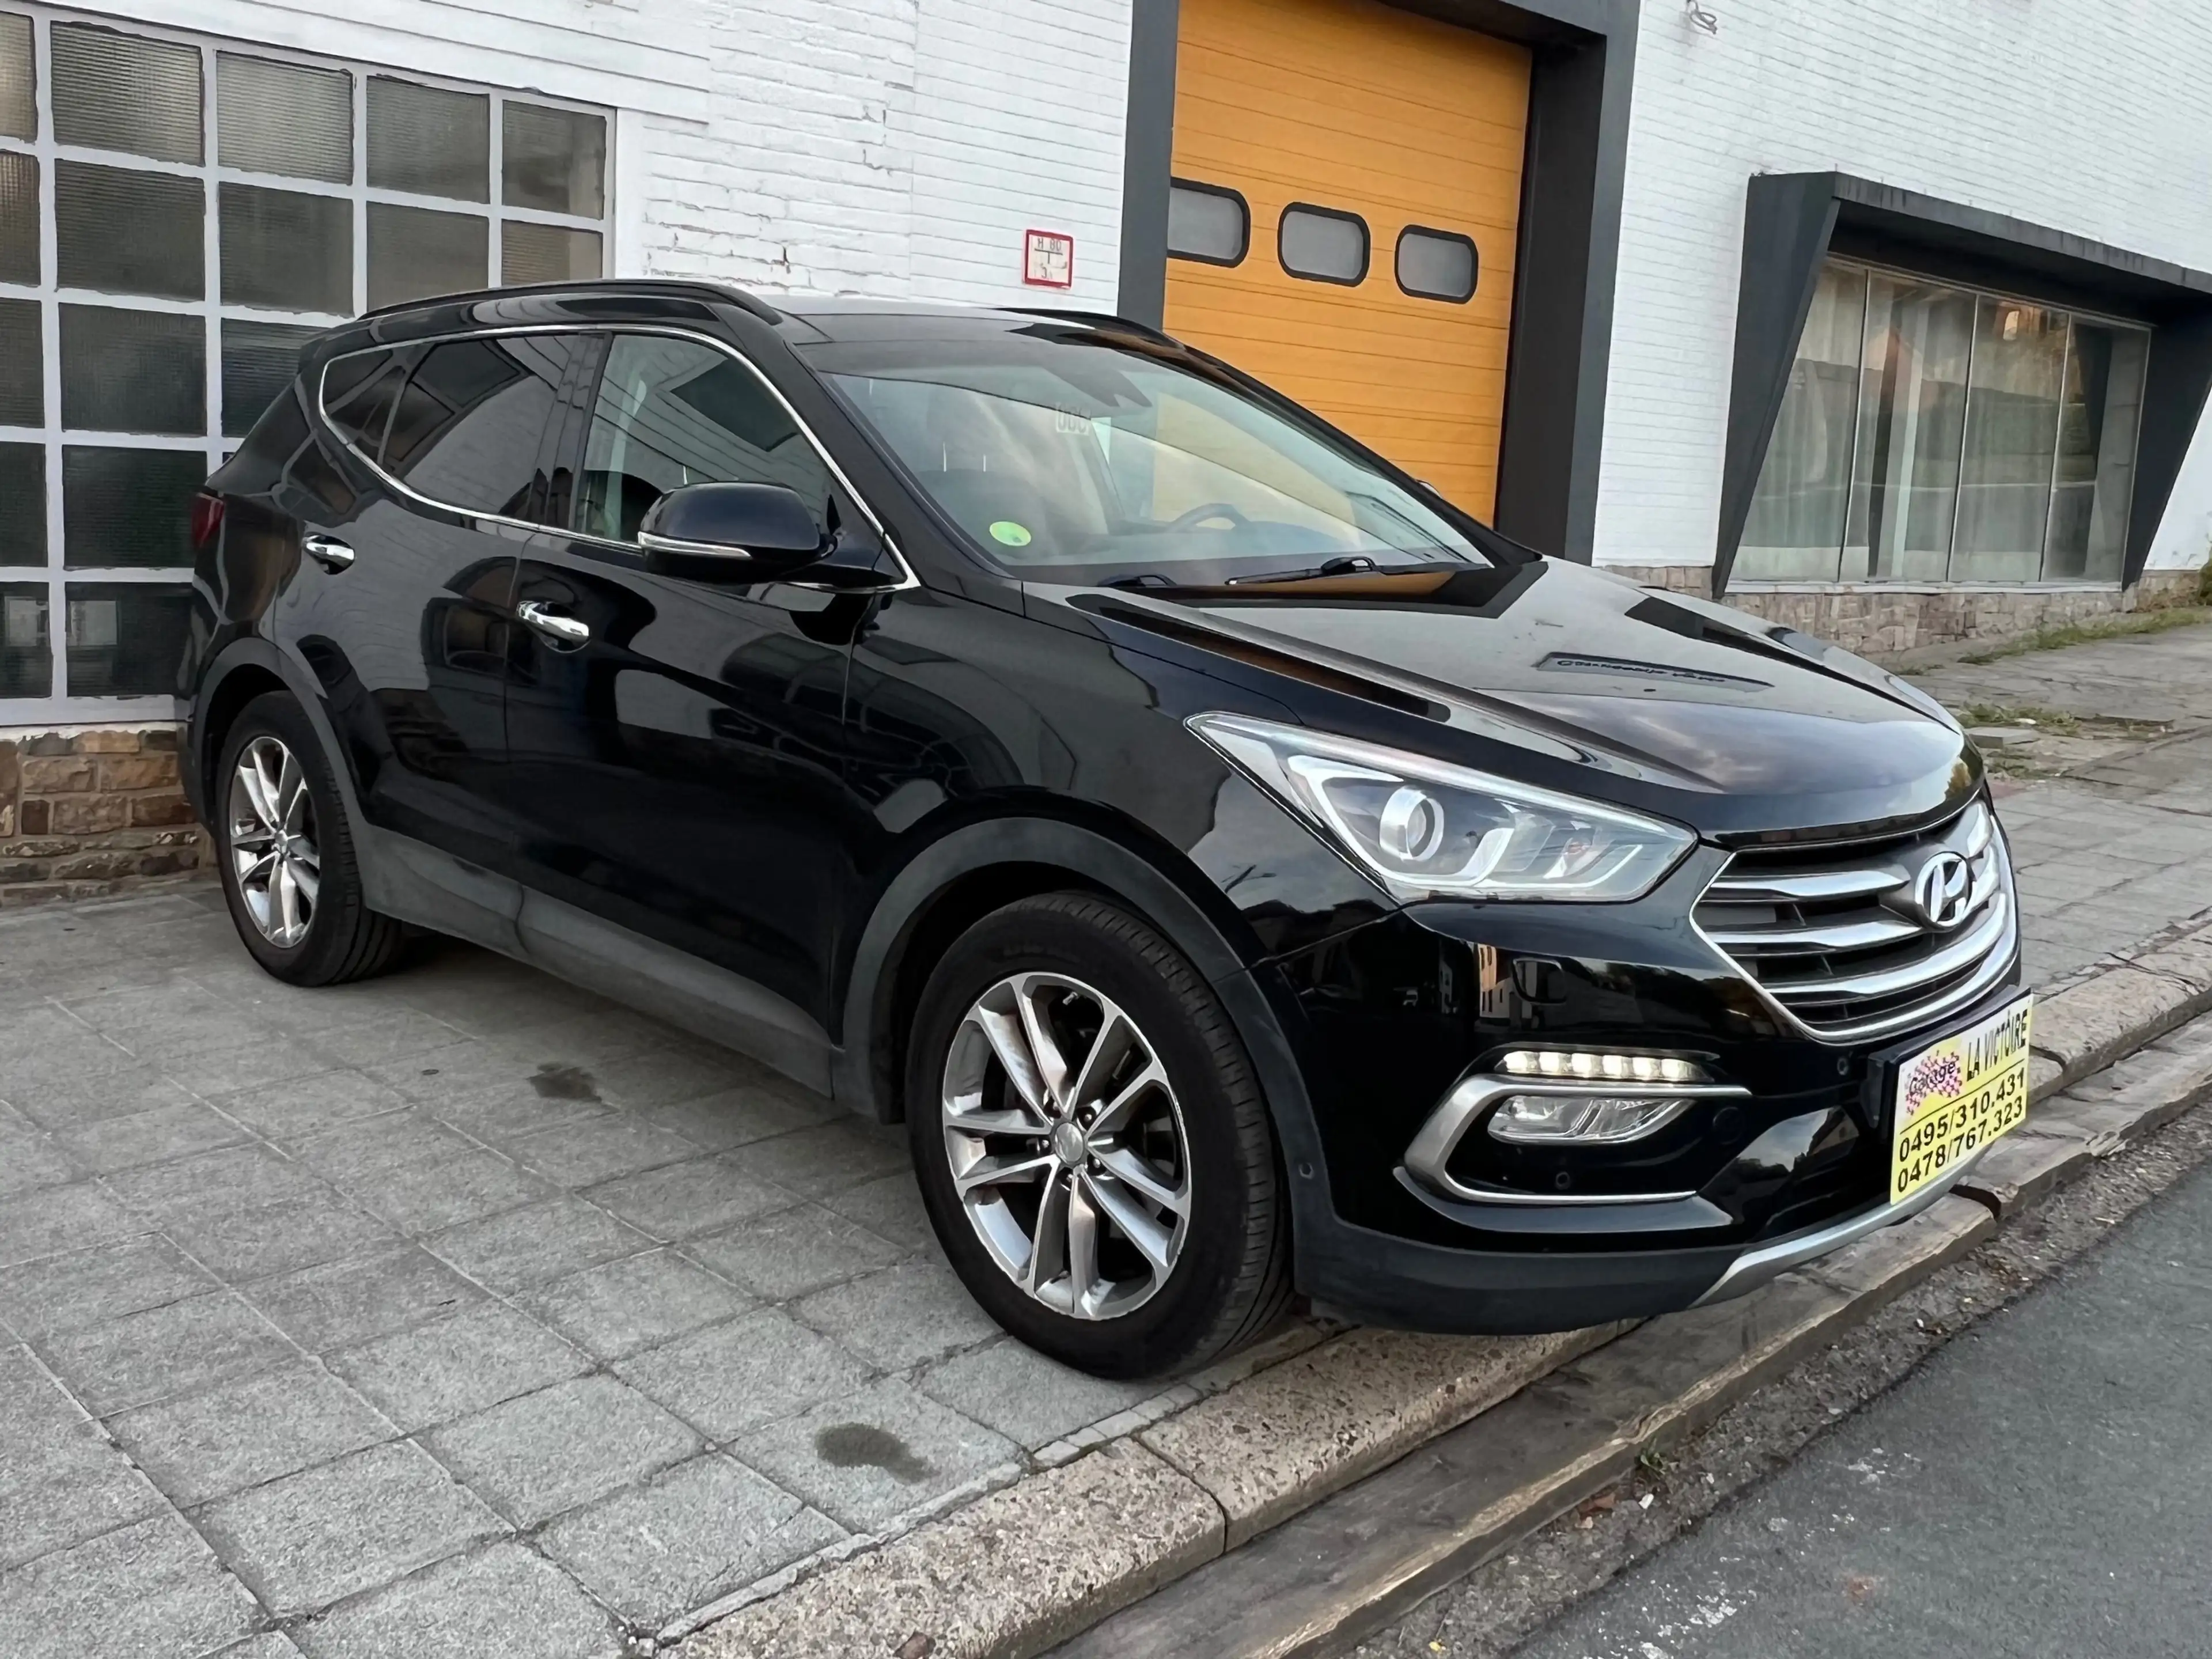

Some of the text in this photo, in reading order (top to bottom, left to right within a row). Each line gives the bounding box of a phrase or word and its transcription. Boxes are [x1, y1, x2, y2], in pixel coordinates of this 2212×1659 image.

[1037, 237, 1044, 249] H
[1967, 1037, 1980, 1082] LA
[1984, 1012, 2028, 1071] VICTOIRE
[1897, 1095, 2022, 1193] 0478/767.323
[1900, 1067, 2024, 1162] 0495/310.431
